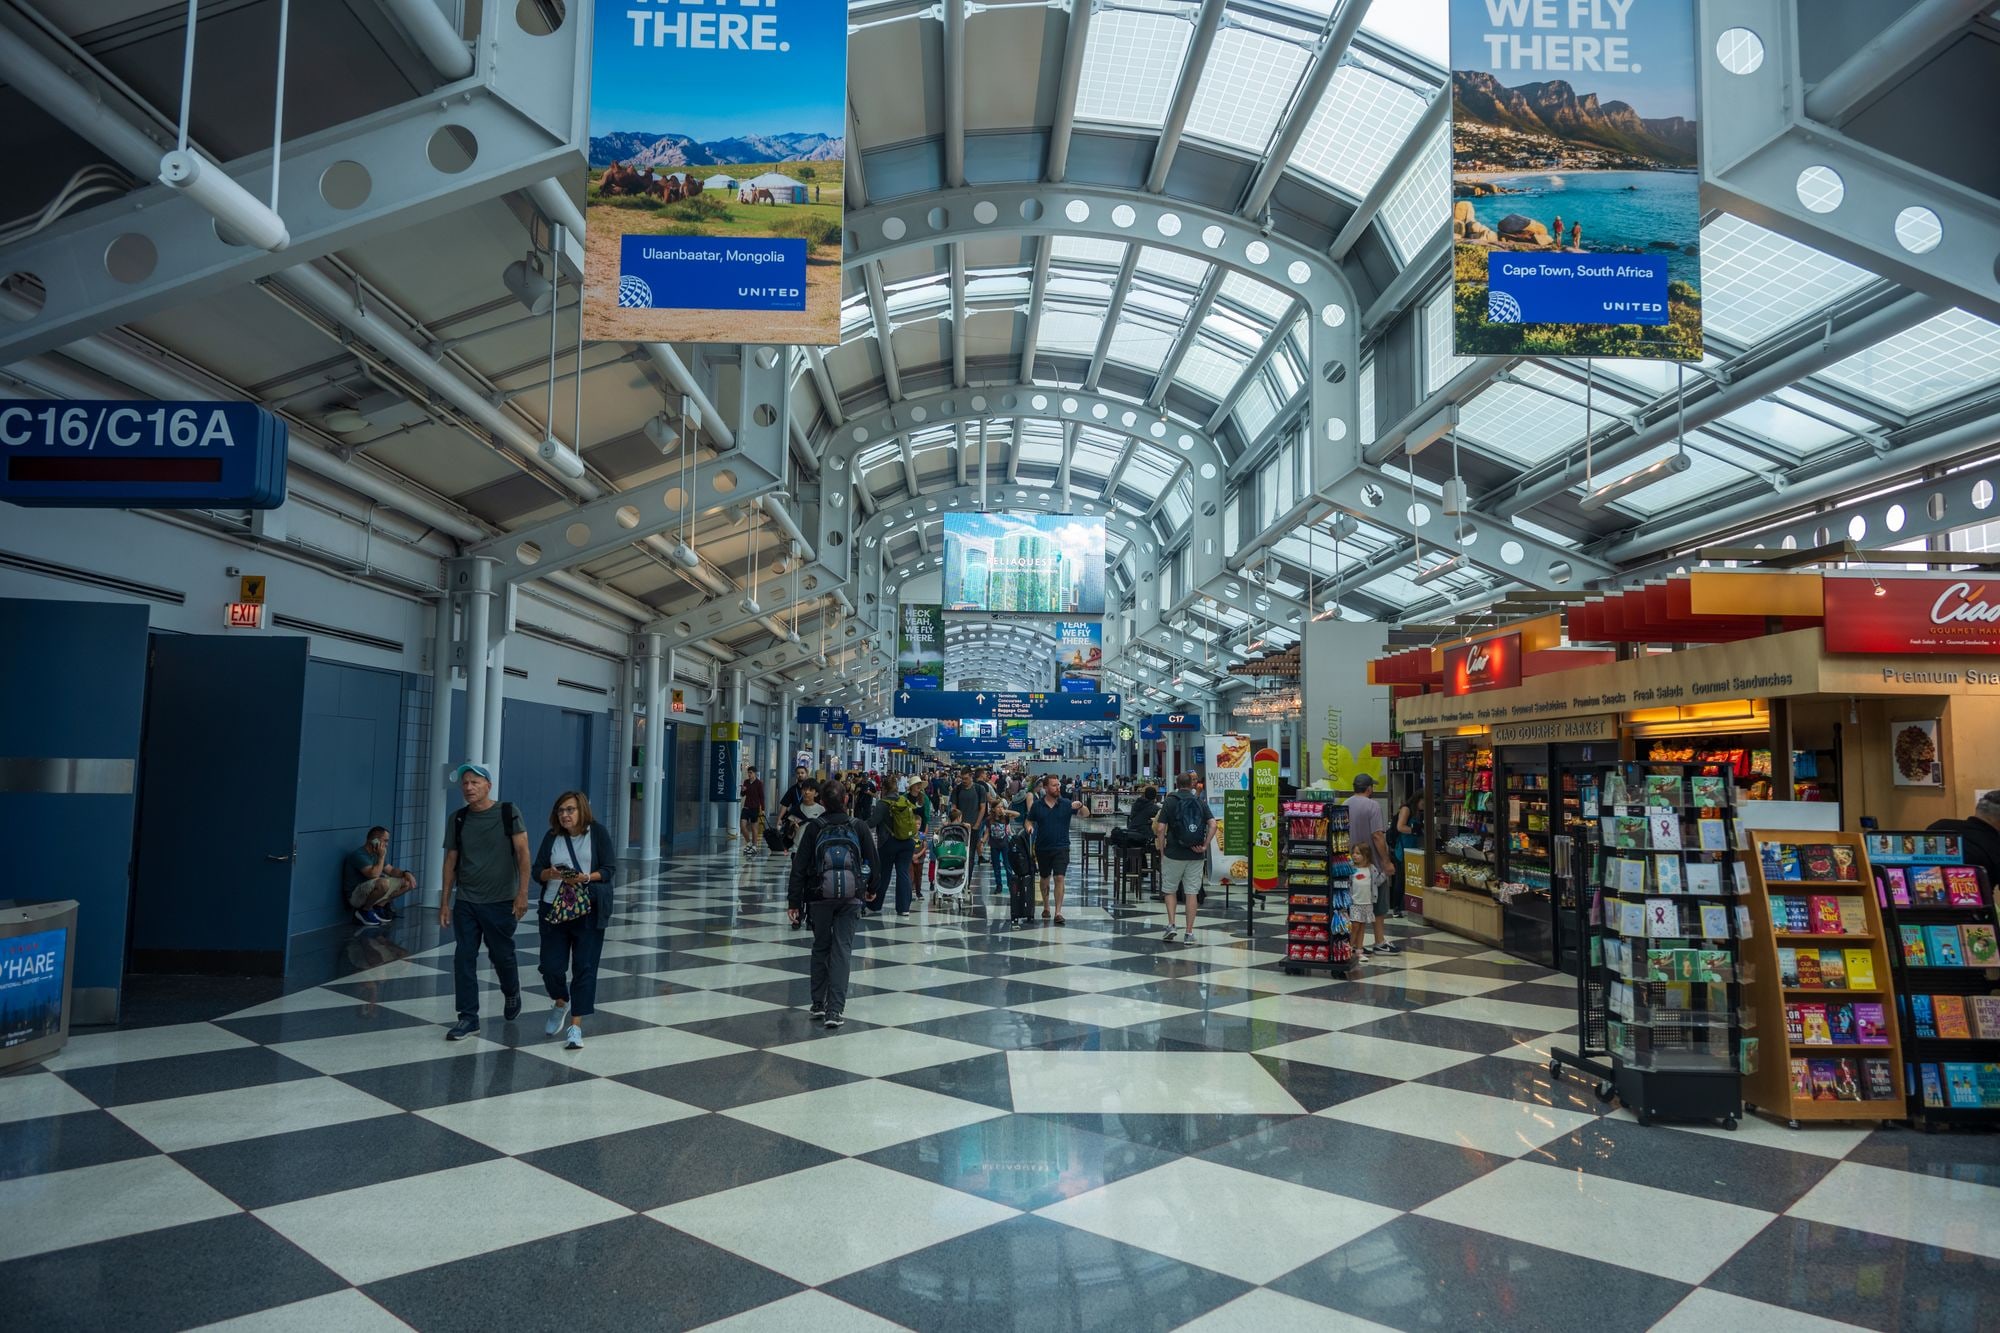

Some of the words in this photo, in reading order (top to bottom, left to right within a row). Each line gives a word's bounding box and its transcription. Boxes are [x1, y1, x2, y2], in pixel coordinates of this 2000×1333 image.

[1484, 0, 1557, 28] WE
[1568, 0, 1634, 30] FLY
[626, 10, 790, 52] THERE.
[1483, 34, 1642, 74] THERE.
[642, 248, 723, 263] Ulaanbaatar,
[726, 250, 784, 264] Mongolia
[1502, 264, 1537, 278] Cape
[1538, 265, 1575, 278] Town,
[1577, 265, 1614, 277] South
[1616, 266, 1653, 278] Africa
[738, 287, 799, 297] UNITED
[1603, 302, 1662, 312] UNITED
[0, 407, 235, 450] C16/C16A
[231, 603, 258, 622] EXIT
[905, 609, 930, 617] HECK
[905, 618, 932, 626] YEAH,
[905, 634, 935, 642] THERE.
[1078, 629, 1091, 637] FLY
[1062, 637, 1091, 645] THERE.
[1882, 667, 1958, 684] Premium
[1573, 695, 1600, 708] Premium
[1602, 693, 1626, 706] Snacks
[1633, 689, 1654, 701] Fresh
[1656, 685, 1683, 699] Salads
[1691, 680, 1730, 695] Gourmet
[1733, 673, 1793, 690] Sandwiches
[1168, 715, 1184, 723] C17
[1495, 725, 1515, 741] CIAO
[1518, 721, 1561, 738] GOURMET
[1565, 719, 1605, 737] MARKET
[718, 744, 726, 767] YOU
[1208, 771, 1240, 780] WICKER
[1256, 768, 1271, 776] eat
[717, 768, 726, 795] NEAR
[1213, 780, 1235, 788] PARK
[1257, 775, 1276, 786] well
[1097, 800, 1108, 808] #1
[1407, 862, 1420, 874] PAY
[1406, 875, 1422, 888] HERE
